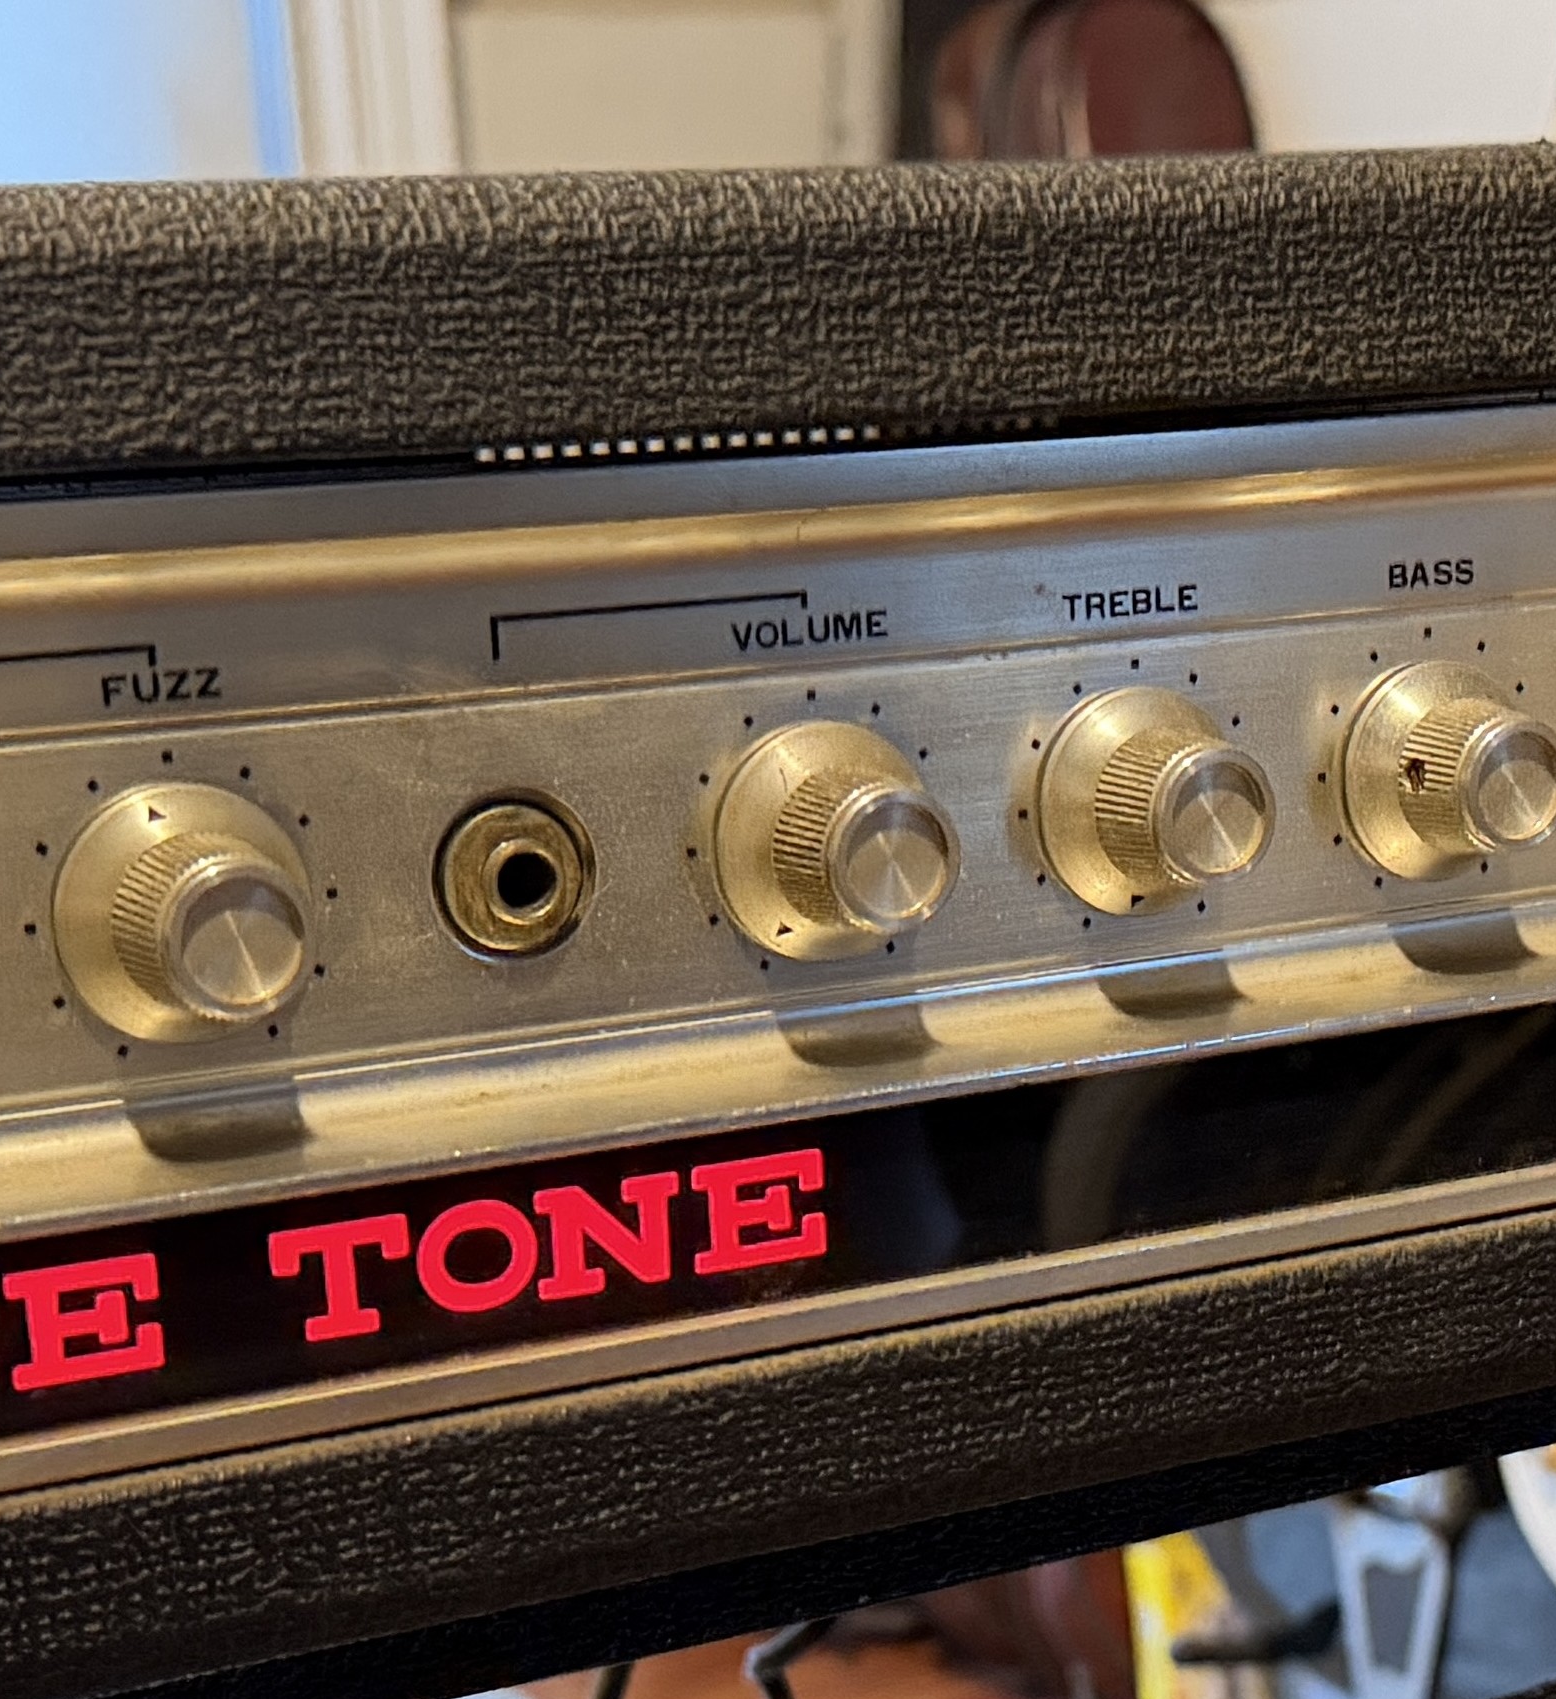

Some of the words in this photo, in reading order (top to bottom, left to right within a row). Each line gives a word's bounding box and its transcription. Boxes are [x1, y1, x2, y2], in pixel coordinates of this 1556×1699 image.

[1388, 558, 1475, 591] BASS
[1062, 584, 1199, 622] TREBLE
[730, 609, 888, 653] VOLUME
[101, 667, 222, 707] FUZZ
[268, 1147, 828, 1343] TONE
